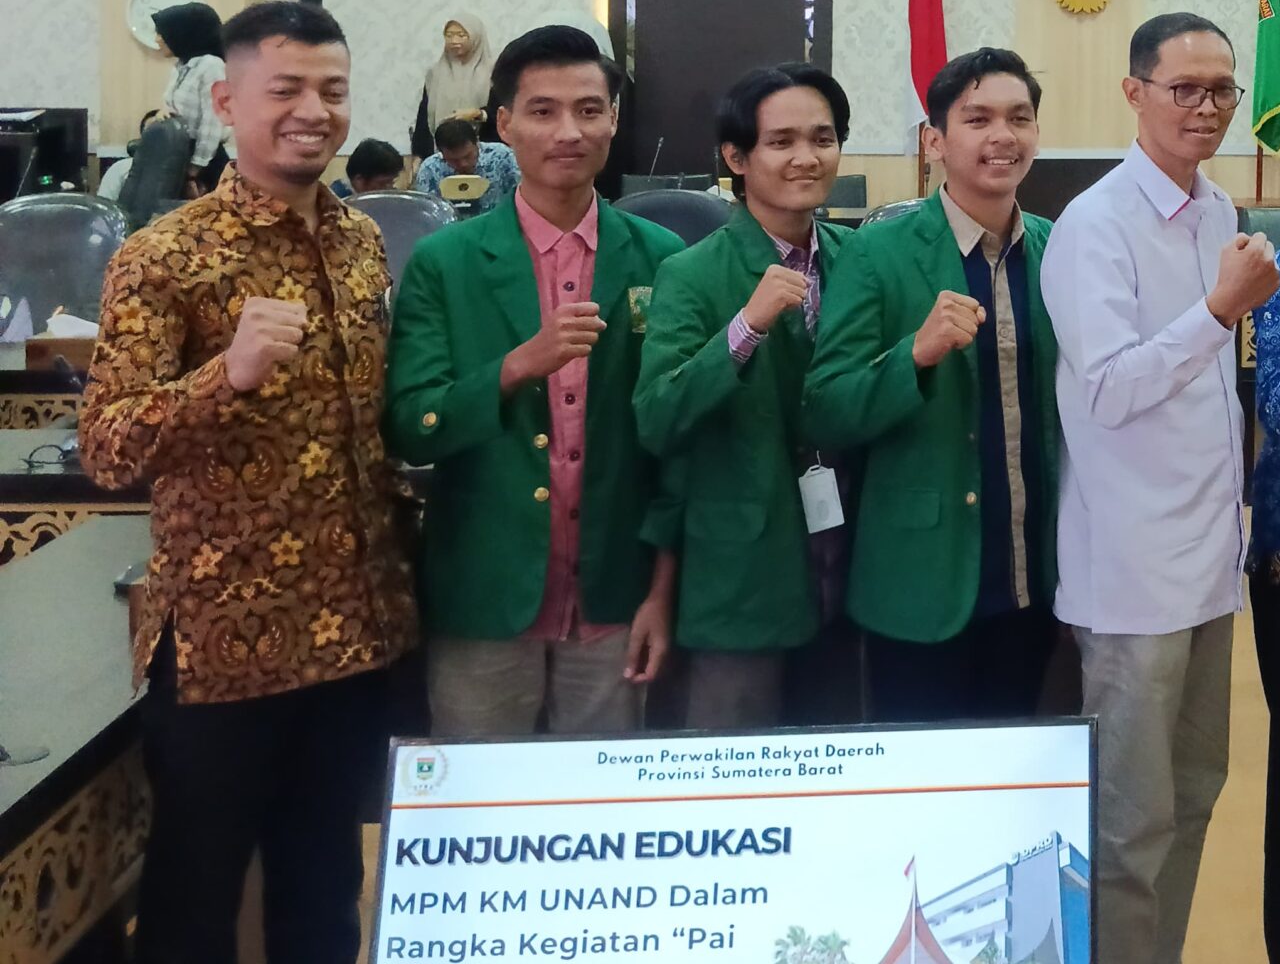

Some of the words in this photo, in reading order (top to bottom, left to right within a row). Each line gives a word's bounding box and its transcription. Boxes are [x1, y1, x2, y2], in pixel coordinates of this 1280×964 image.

[597, 751, 653, 765] Dewan
[660, 747, 755, 763] Perwakilan
[761, 745, 819, 762] Rakyat
[825, 742, 885, 757] Daerah
[638, 767, 705, 781] Provinsi
[711, 765, 792, 779] Sumatera
[798, 762, 843, 776] Barat
[395, 832, 626, 867] KUNJUNGAN
[634, 826, 792, 859] EDUKASI
[390, 891, 467, 915] MPM
[479, 890, 527, 913] KM
[540, 886, 657, 912] UNAND
[669, 882, 768, 907] Dalam
[386, 933, 506, 964] Rangka
[519, 929, 659, 962] Kegiatan
[672, 924, 735, 951] “Pai
